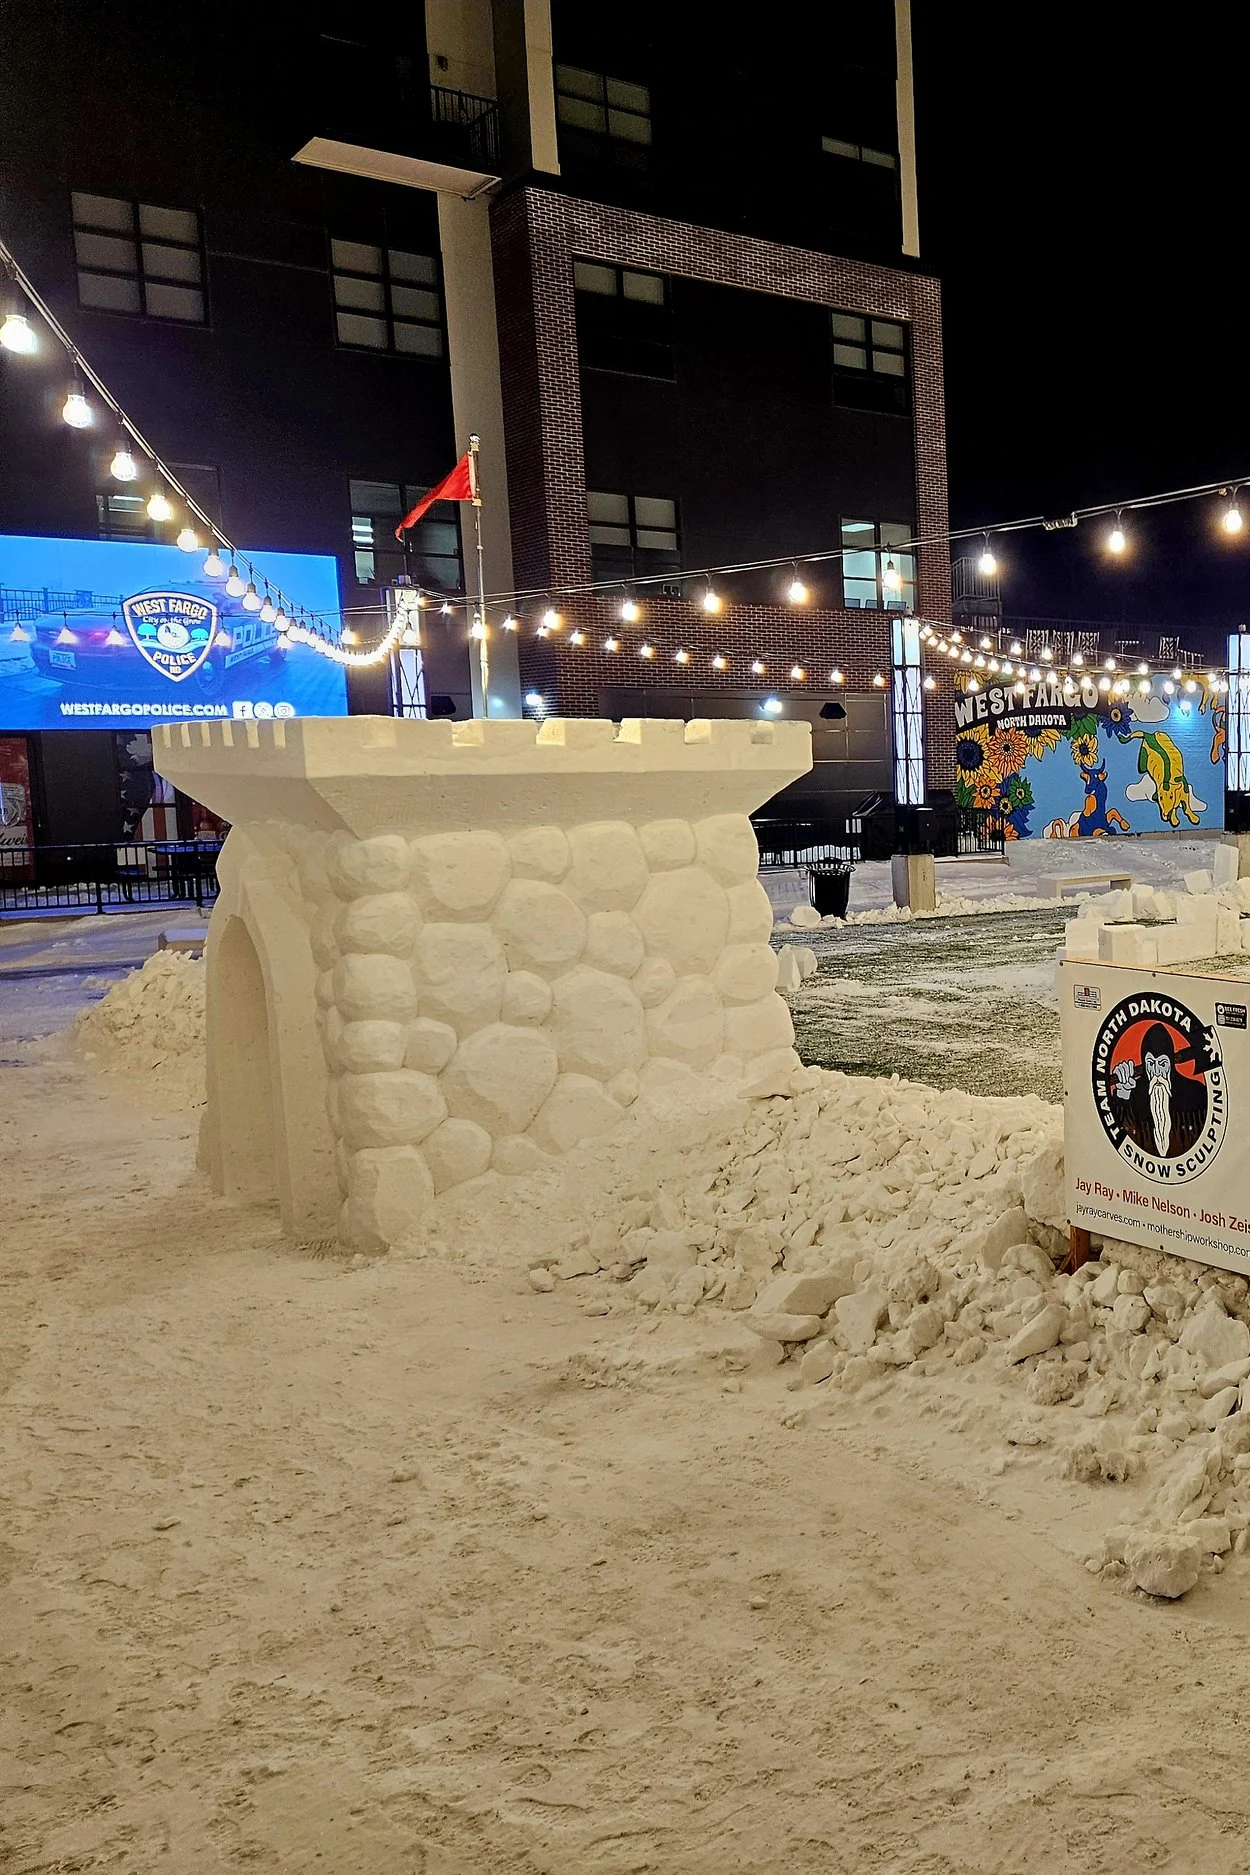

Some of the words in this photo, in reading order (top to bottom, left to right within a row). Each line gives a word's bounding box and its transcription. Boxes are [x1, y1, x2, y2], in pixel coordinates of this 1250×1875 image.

[131, 598, 168, 617] WEST
[168, 598, 209, 620] FARGO
[142, 616, 159, 626] City
[170, 616, 182, 624] the
[153, 650, 197, 666] POLICE
[60, 702, 229, 717] WESTFARGOPOLICE.COM
[954, 685, 1018, 728] WEST
[1022, 682, 1099, 709] FARGO
[996, 715, 1027, 730] NORTH
[1028, 714, 1067, 727] DAKOTA
[1128, 999, 1191, 1033] DAKOTA
[1096, 1009, 1128, 1074] NORTH
[1097, 1080, 1122, 1141] TEAM
[1123, 1143, 1171, 1178] SNOW
[1175, 1071, 1223, 1177] SCULPTING
[1075, 1178, 1092, 1195] Jay
[1094, 1182, 1114, 1200] Ray
[1122, 1190, 1149, 1207] Mike
[1152, 1196, 1190, 1219] Nelson
[1200, 1209, 1226, 1228] Josh
[1076, 1202, 1141, 1228] jayraycarves.com
